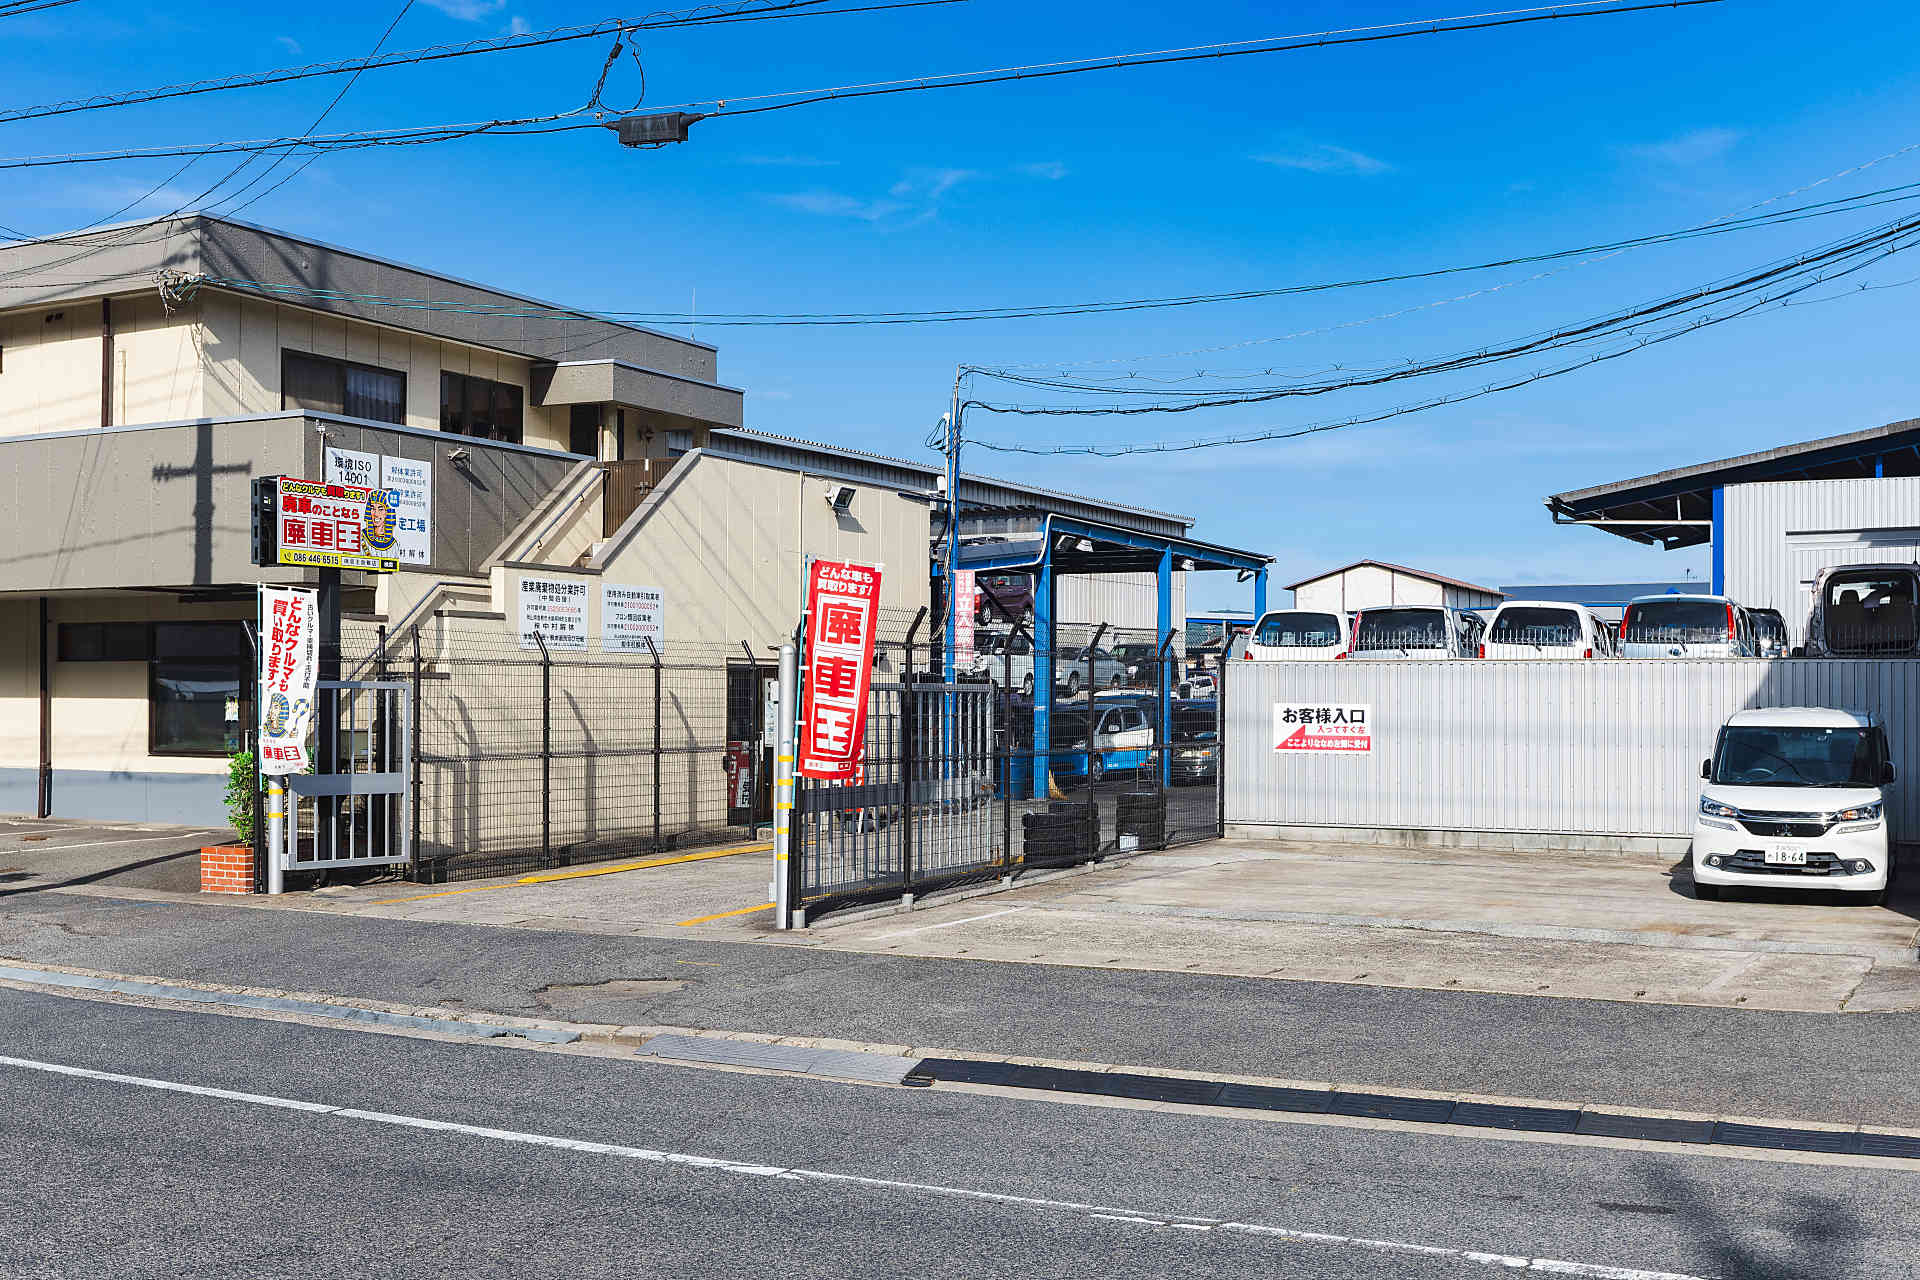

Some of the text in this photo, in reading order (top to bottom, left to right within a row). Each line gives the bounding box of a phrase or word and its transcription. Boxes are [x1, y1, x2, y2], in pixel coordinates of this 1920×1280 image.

[340, 471, 368, 485] 14001
[282, 495, 360, 520] 廃車のことなら
[282, 515, 361, 552] 廃車王
[819, 566, 873, 584] どんな車も
[279, 596, 304, 692] どんなクルマも
[1282, 708, 1365, 724] お客様入口
